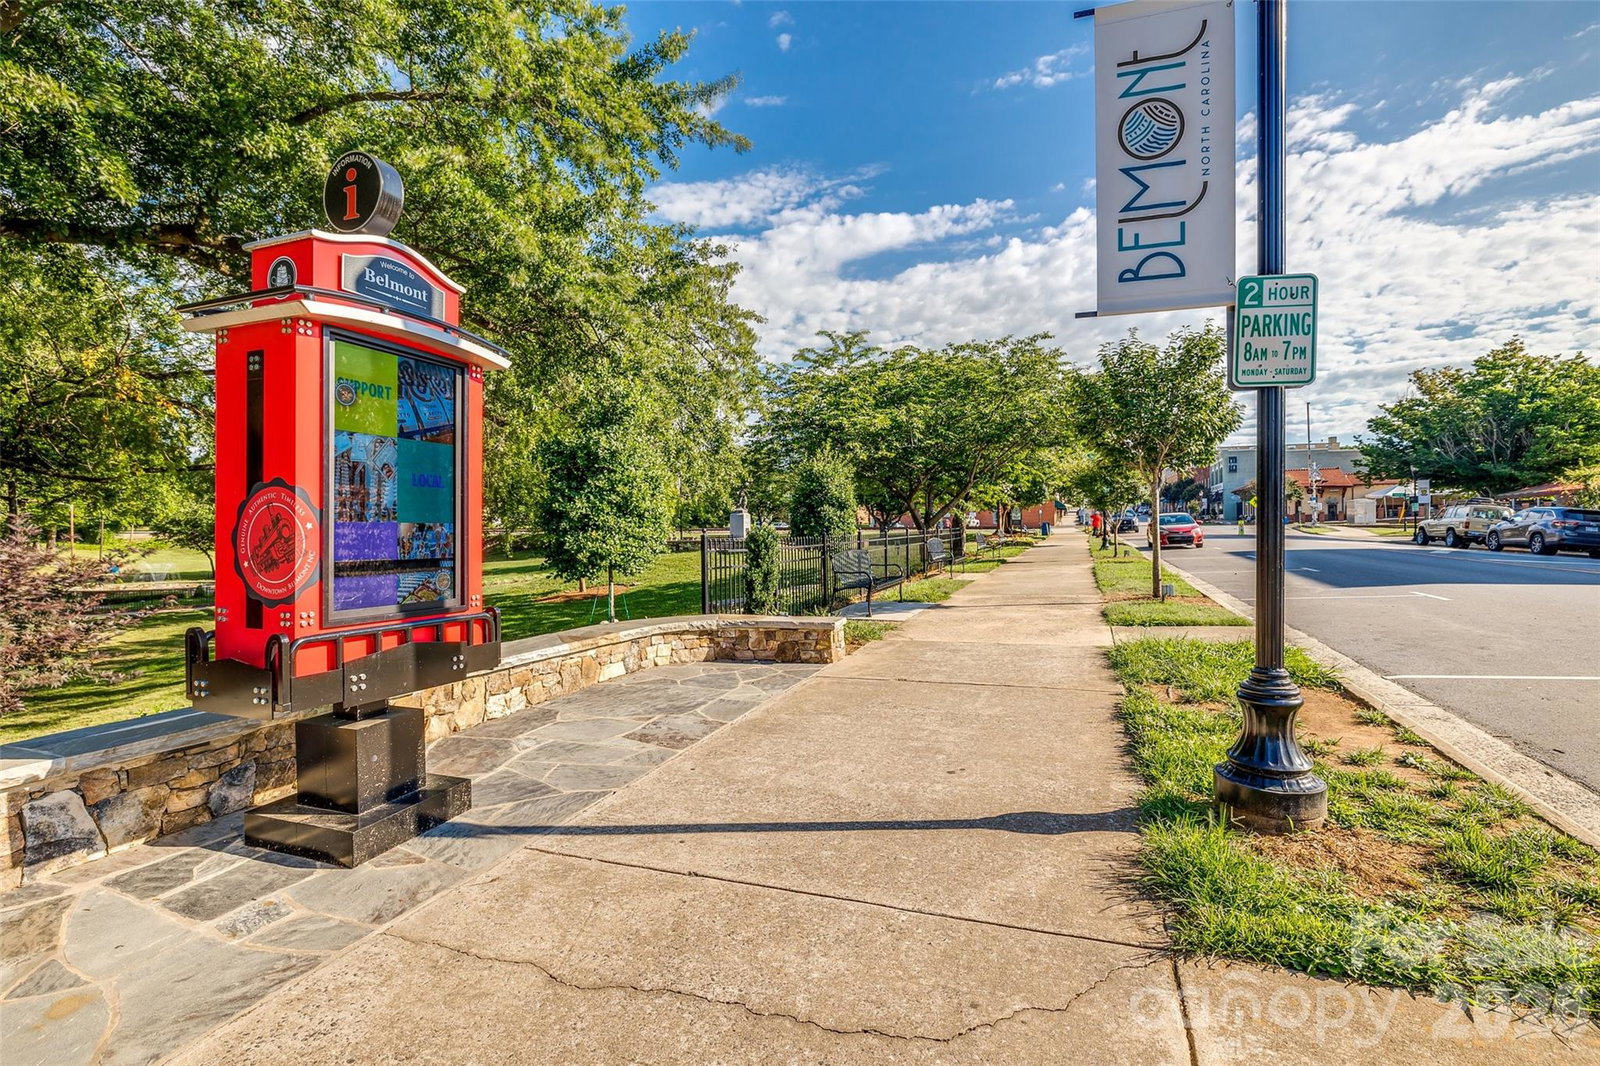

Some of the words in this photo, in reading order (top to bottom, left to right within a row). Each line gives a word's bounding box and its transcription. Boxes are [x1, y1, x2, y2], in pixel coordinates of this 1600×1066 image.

[1201, 40, 1210, 117] CAROLINA
[1201, 126, 1210, 176] NORTH
[331, 154, 373, 177] INFORMATION
[343, 167, 360, 220] i
[380, 261, 408, 276] Welcome
[408, 271, 415, 280] to
[363, 266, 428, 303] Belmont
[1244, 281, 1259, 306] 2
[1268, 285, 1310, 300] HOUR
[1241, 312, 1311, 338] PARKING
[1243, 341, 1268, 362] 8AM
[1271, 350, 1279, 358] TO
[1282, 340, 1307, 361] 7PM
[1241, 368, 1268, 377] MONDAY
[1274, 367, 1308, 376] SATURDAY
[411, 472, 445, 489] LOCAL
[240, 519, 249, 554] GENUINE
[248, 492, 277, 516] AUTHENTIC
[256, 581, 287, 595] DOWNTOWN
